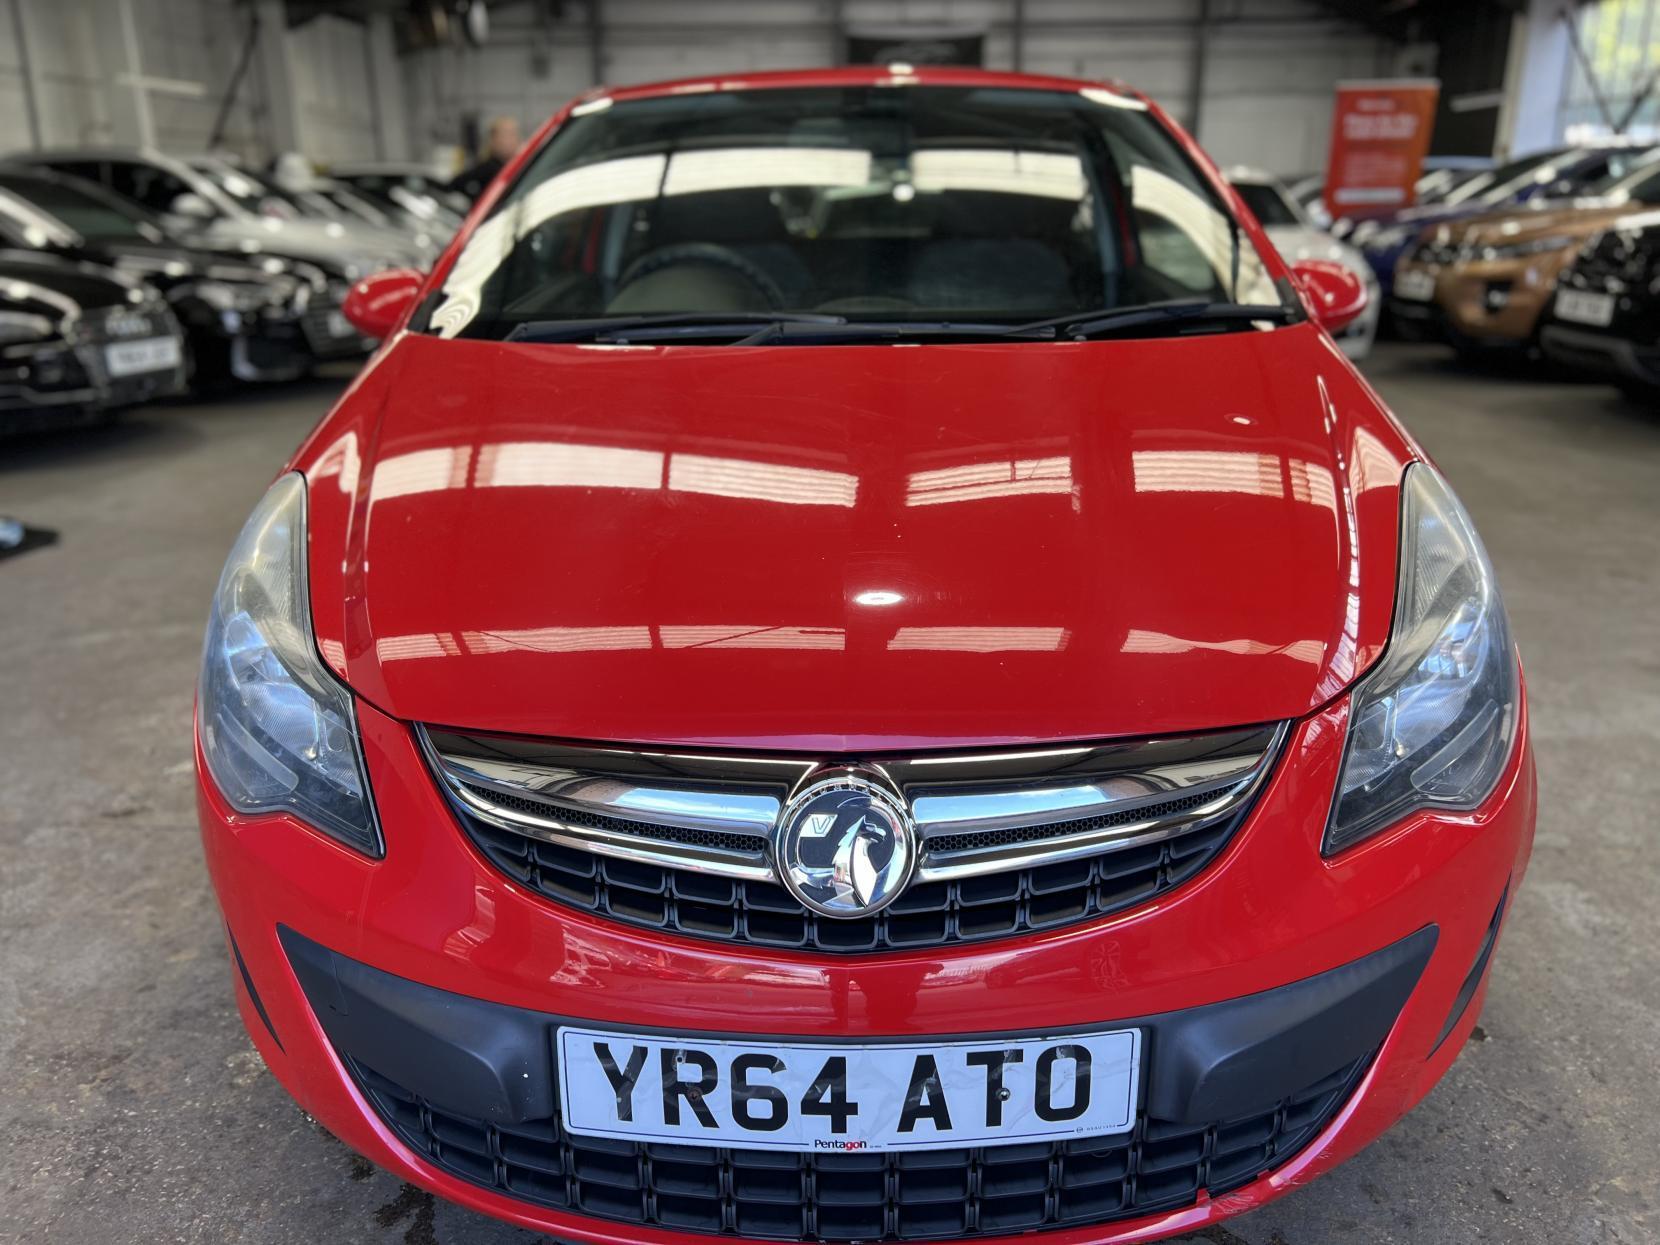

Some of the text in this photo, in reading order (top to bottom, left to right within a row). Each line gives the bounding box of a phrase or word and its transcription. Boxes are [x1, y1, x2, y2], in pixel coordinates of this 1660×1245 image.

[592, 1042, 1092, 1133] YR64 ATO
[814, 1139, 867, 1151] Pentagon
